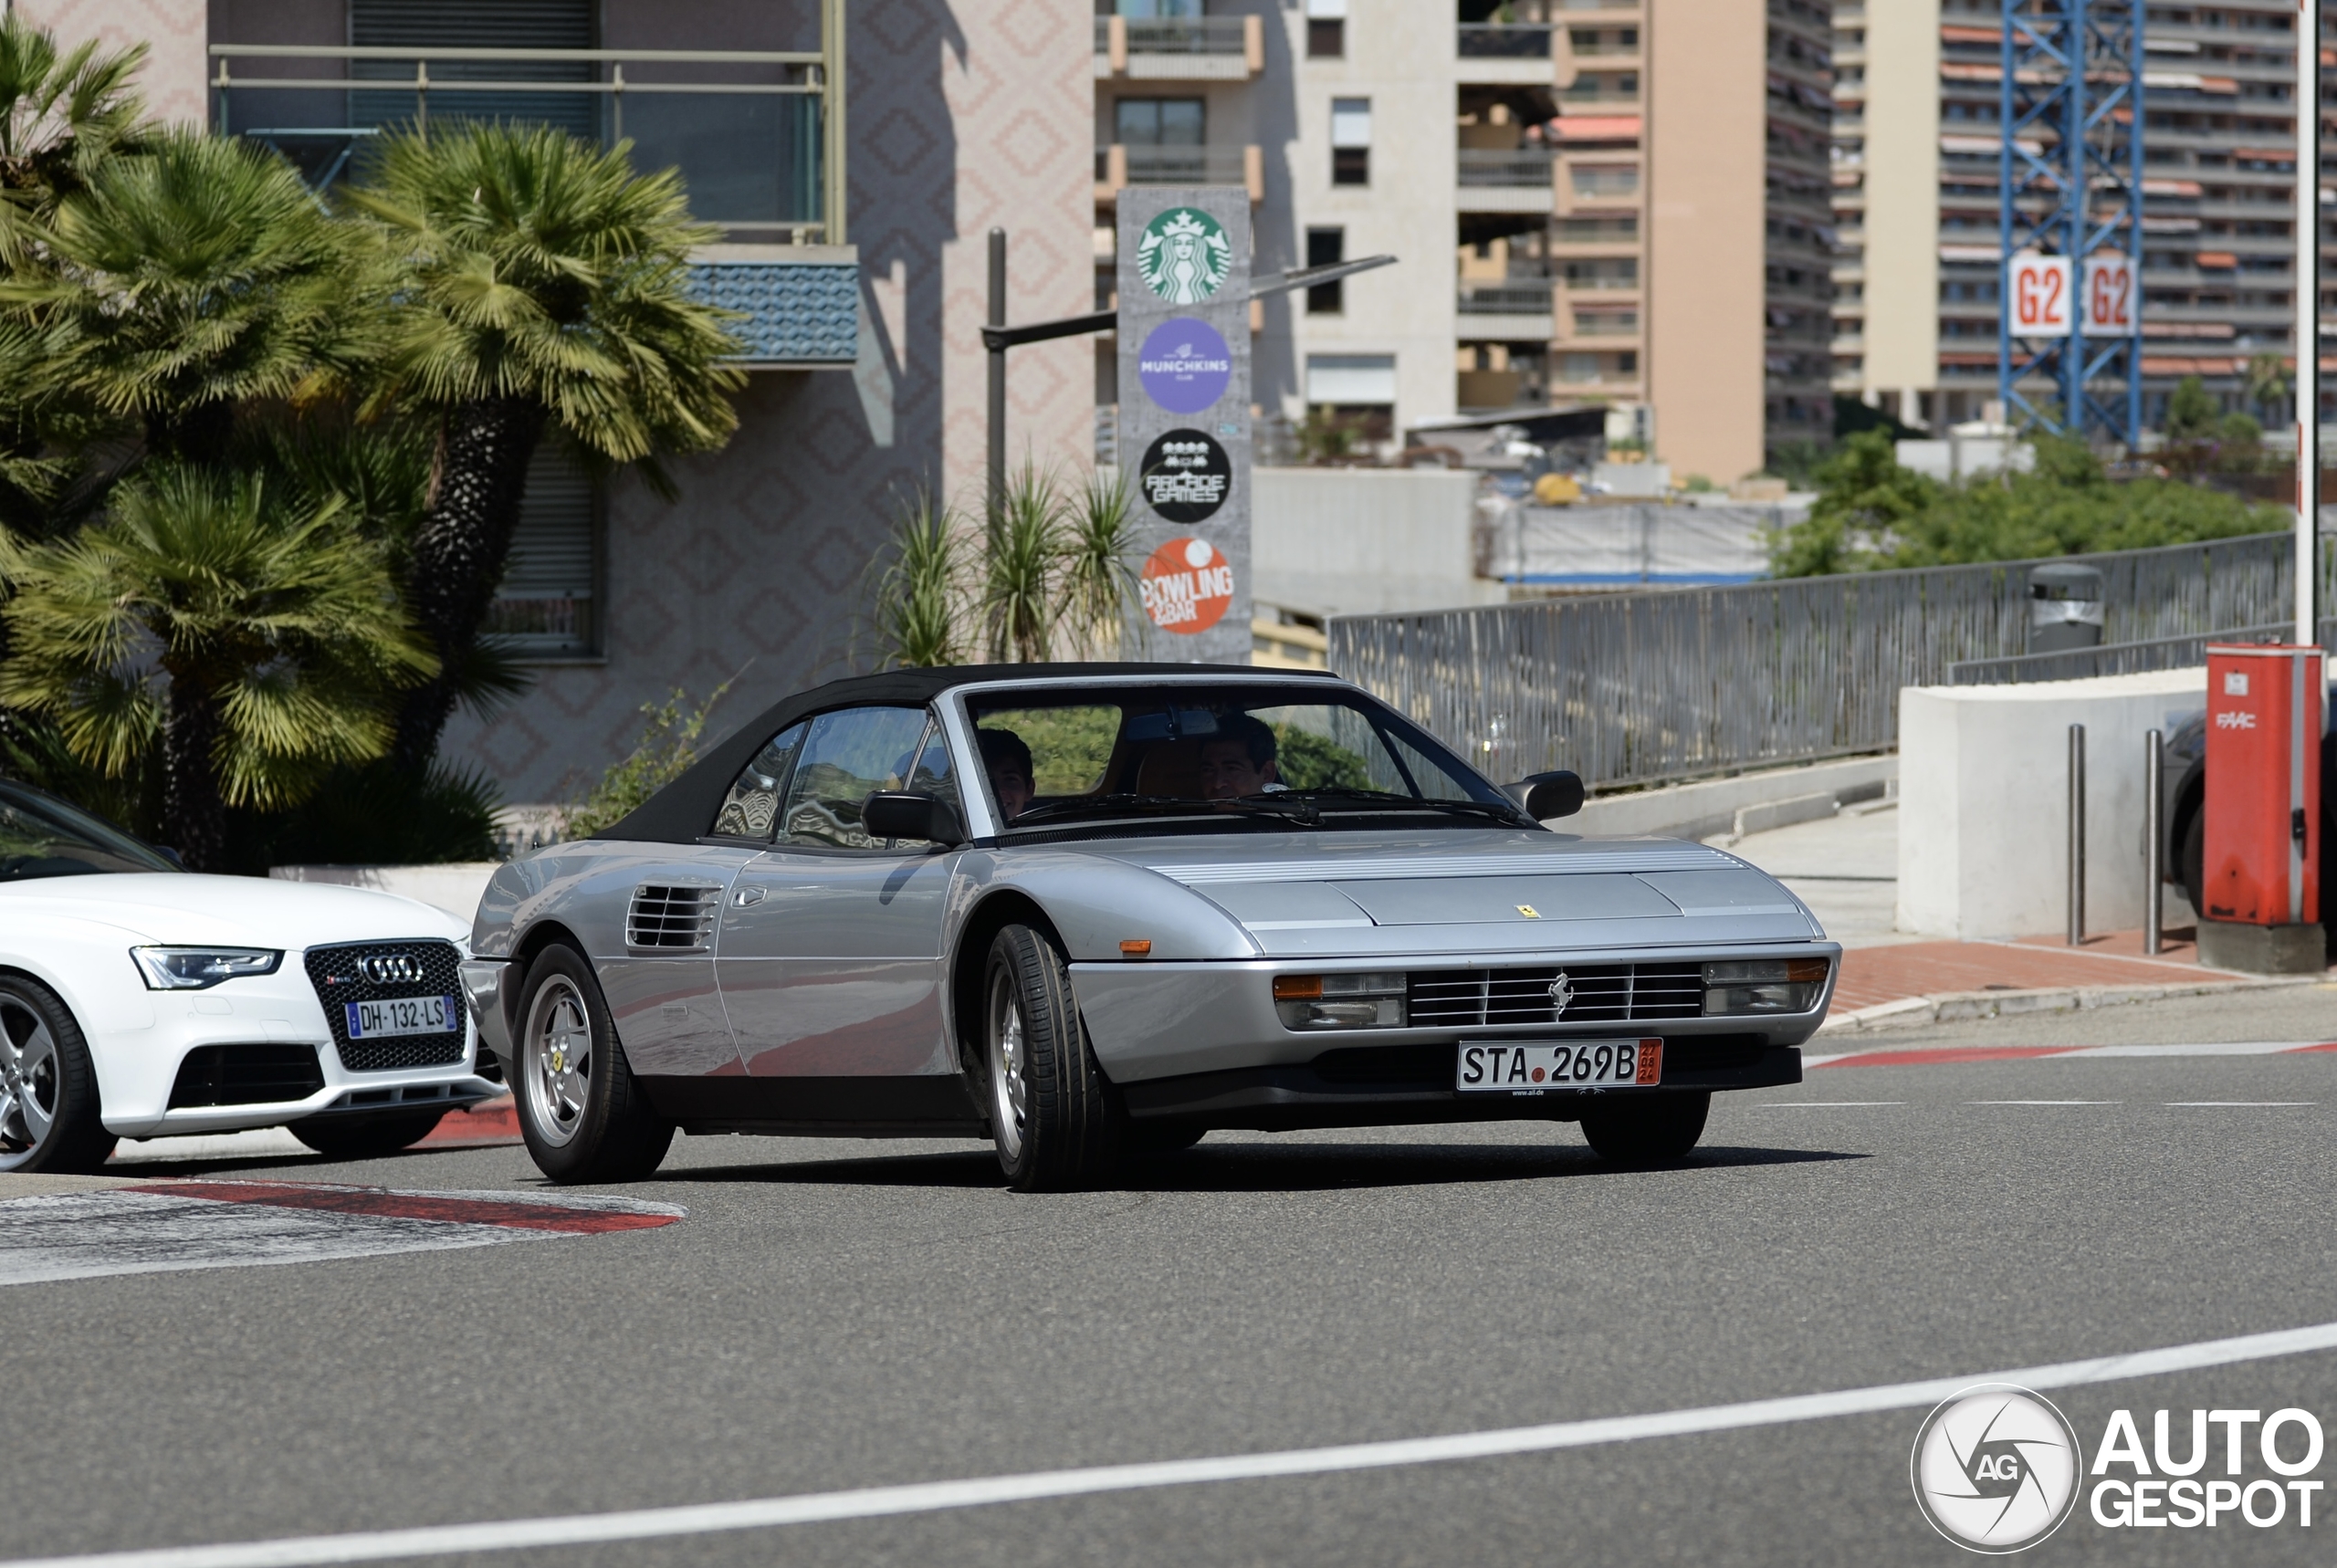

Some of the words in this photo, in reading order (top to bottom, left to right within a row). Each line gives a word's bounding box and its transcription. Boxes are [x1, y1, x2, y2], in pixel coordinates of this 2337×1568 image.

[2018, 267, 2062, 324] G2
[2093, 267, 2129, 324] G2
[1141, 360, 1229, 372] MUNCHKINS
[1146, 475, 1226, 490] ARCADE
[1152, 488, 1220, 503] GAMES
[1138, 566, 1234, 608] BOWLING
[2216, 712, 2256, 730] FAAC
[1463, 1047, 1527, 1083] STA
[1550, 1044, 1635, 1082] 269B
[1640, 1057, 1655, 1067] 08
